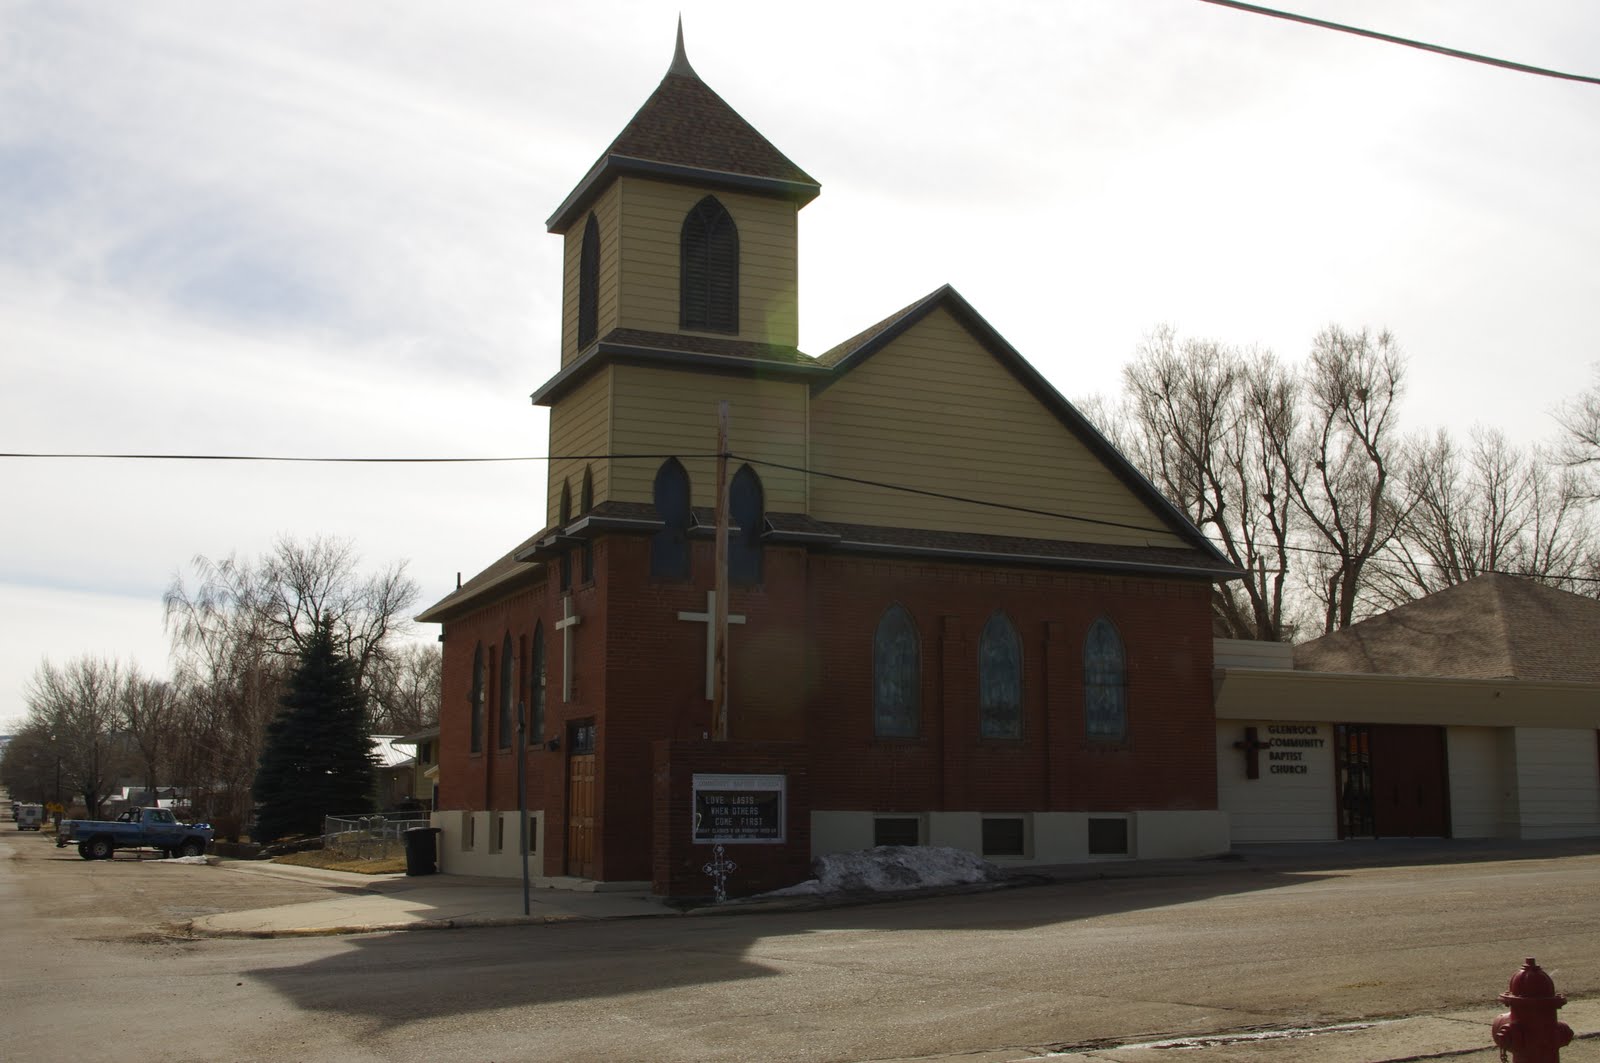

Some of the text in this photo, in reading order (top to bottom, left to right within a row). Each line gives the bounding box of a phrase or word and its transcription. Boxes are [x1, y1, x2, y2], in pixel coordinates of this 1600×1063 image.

[1268, 725, 1317, 734] GLENROCK
[1269, 738, 1324, 747] COMMUNITY
[1269, 751, 1303, 760] BAPTIST
[1270, 765, 1307, 774] CHURCH
[705, 796, 754, 804] LOVE LASTS
[710, 807, 758, 815] WHEN OTHERS
[714, 818, 763, 826] COME FIRST
